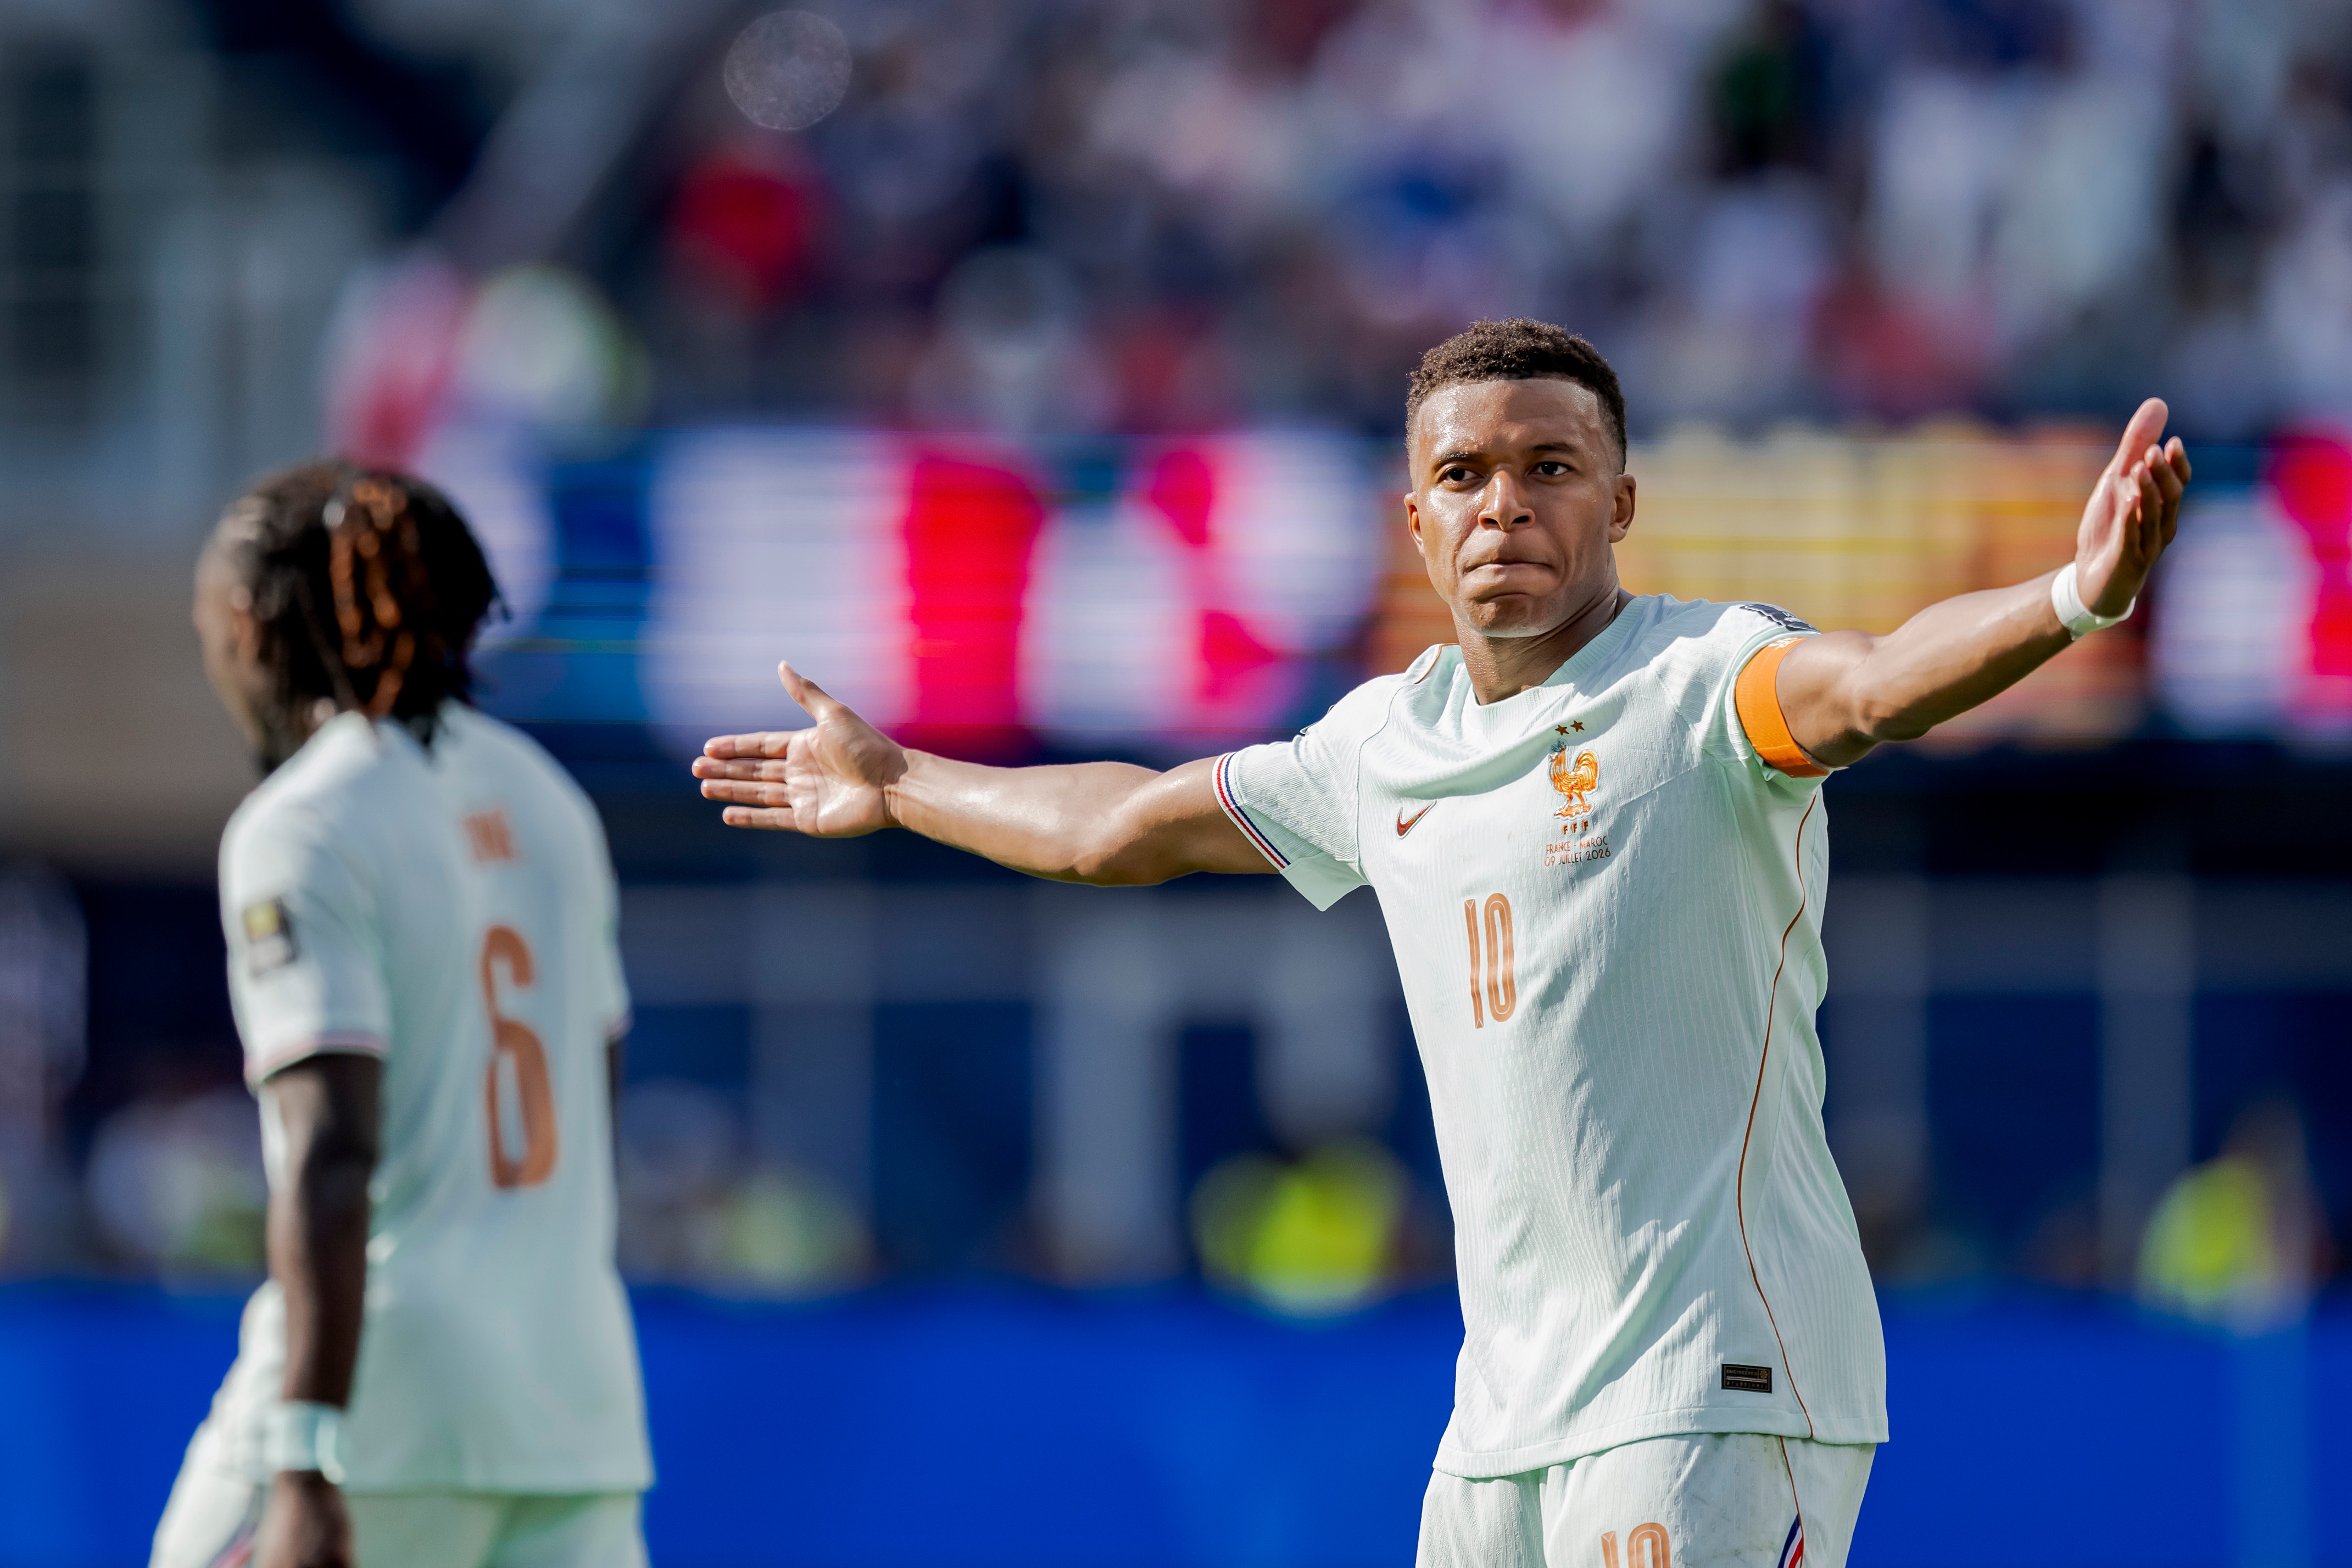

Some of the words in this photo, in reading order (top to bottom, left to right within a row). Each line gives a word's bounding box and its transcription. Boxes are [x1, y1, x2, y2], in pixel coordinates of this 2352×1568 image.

[1544, 855, 1556, 867] 09
[1558, 852, 1583, 865] JUILLET
[1585, 847, 1611, 861] 2026
[1546, 840, 1570, 855] FRANCE
[1579, 836, 1608, 849] MAROC
[1464, 893, 1516, 1029] 10
[482, 925, 558, 1190] 6
